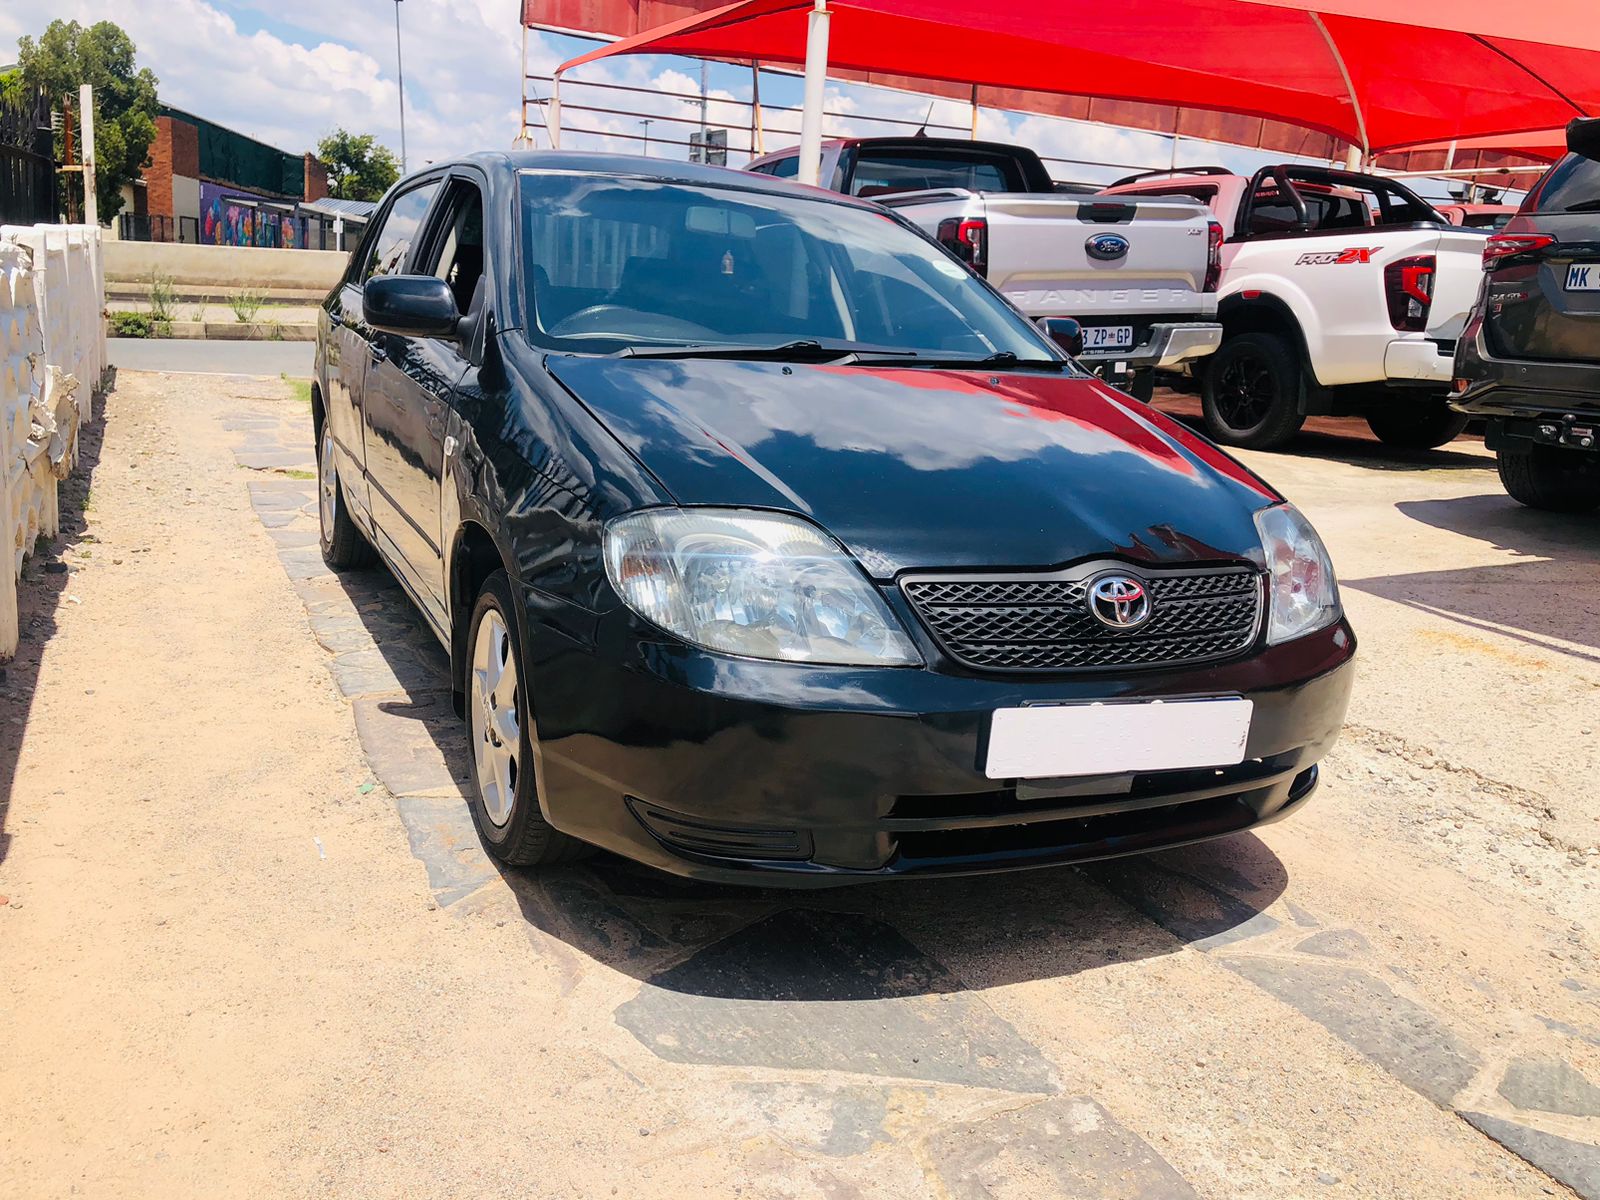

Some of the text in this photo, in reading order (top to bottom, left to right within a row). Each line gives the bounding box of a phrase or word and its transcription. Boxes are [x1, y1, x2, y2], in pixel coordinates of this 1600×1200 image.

[1101, 240, 1121, 252] Ford
[1568, 267, 1591, 287] MK
[1012, 289, 1189, 305] RANGER
[1093, 329, 1108, 345] ZP
[1117, 328, 1130, 344] GP
